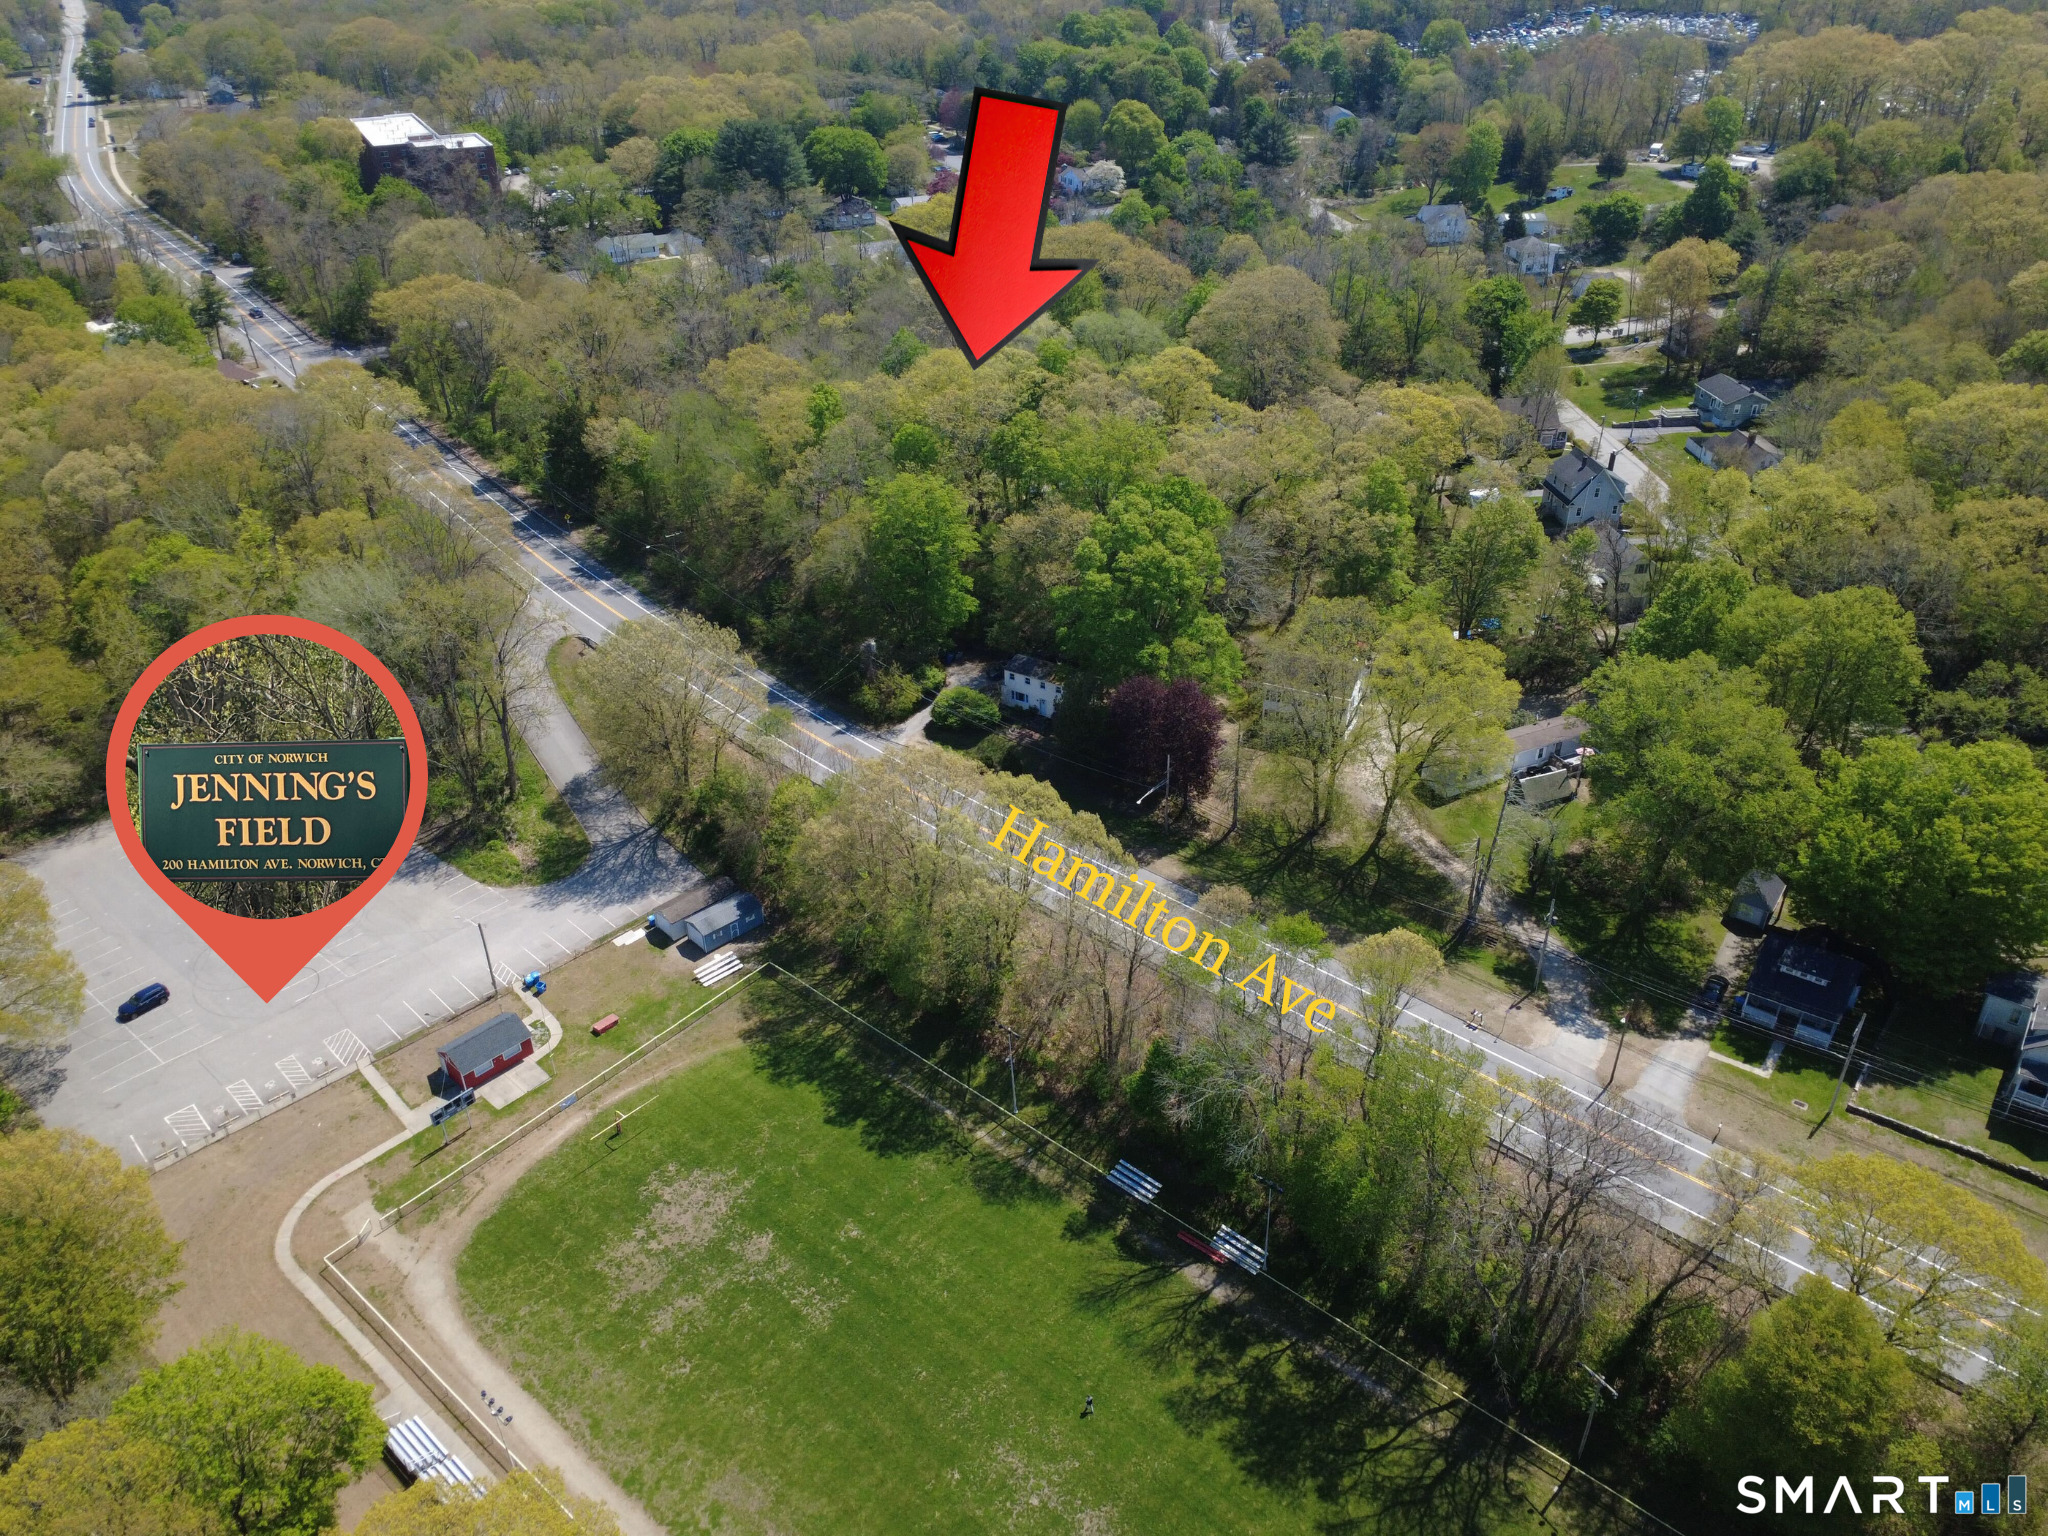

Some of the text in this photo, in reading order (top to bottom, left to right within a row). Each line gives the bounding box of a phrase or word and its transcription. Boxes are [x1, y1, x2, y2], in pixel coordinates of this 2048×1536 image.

[214, 753, 328, 764] CITY OF NORWICH
[171, 771, 376, 810] JENNING'S
[215, 817, 331, 846] FIELD
[162, 859, 183, 870] 200
[188, 859, 259, 870] HAMILTON
[264, 858, 292, 869] AVE.
[298, 858, 366, 870] NORWICH,
